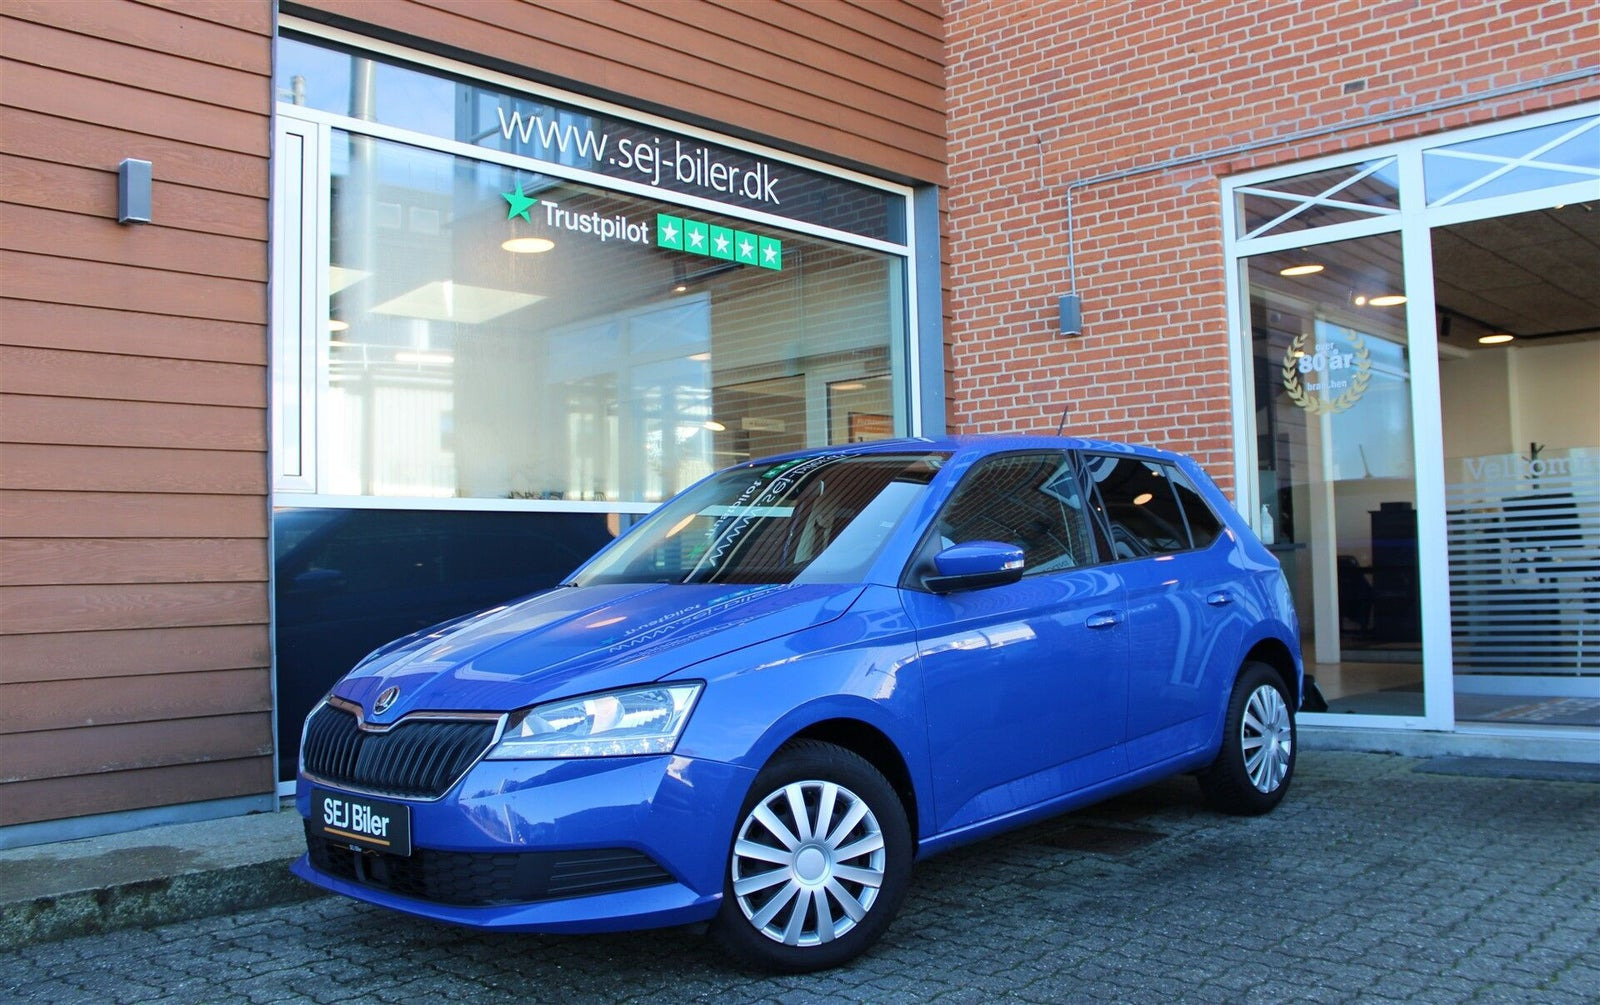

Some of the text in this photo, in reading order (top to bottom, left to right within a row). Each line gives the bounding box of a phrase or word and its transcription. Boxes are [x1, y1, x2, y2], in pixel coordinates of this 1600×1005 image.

[497, 106, 781, 206] www.sej-biler.dk
[541, 200, 649, 244] Trustpilot
[1298, 348, 1353, 374] 80 år
[323, 797, 390, 837] SEJ Biler
